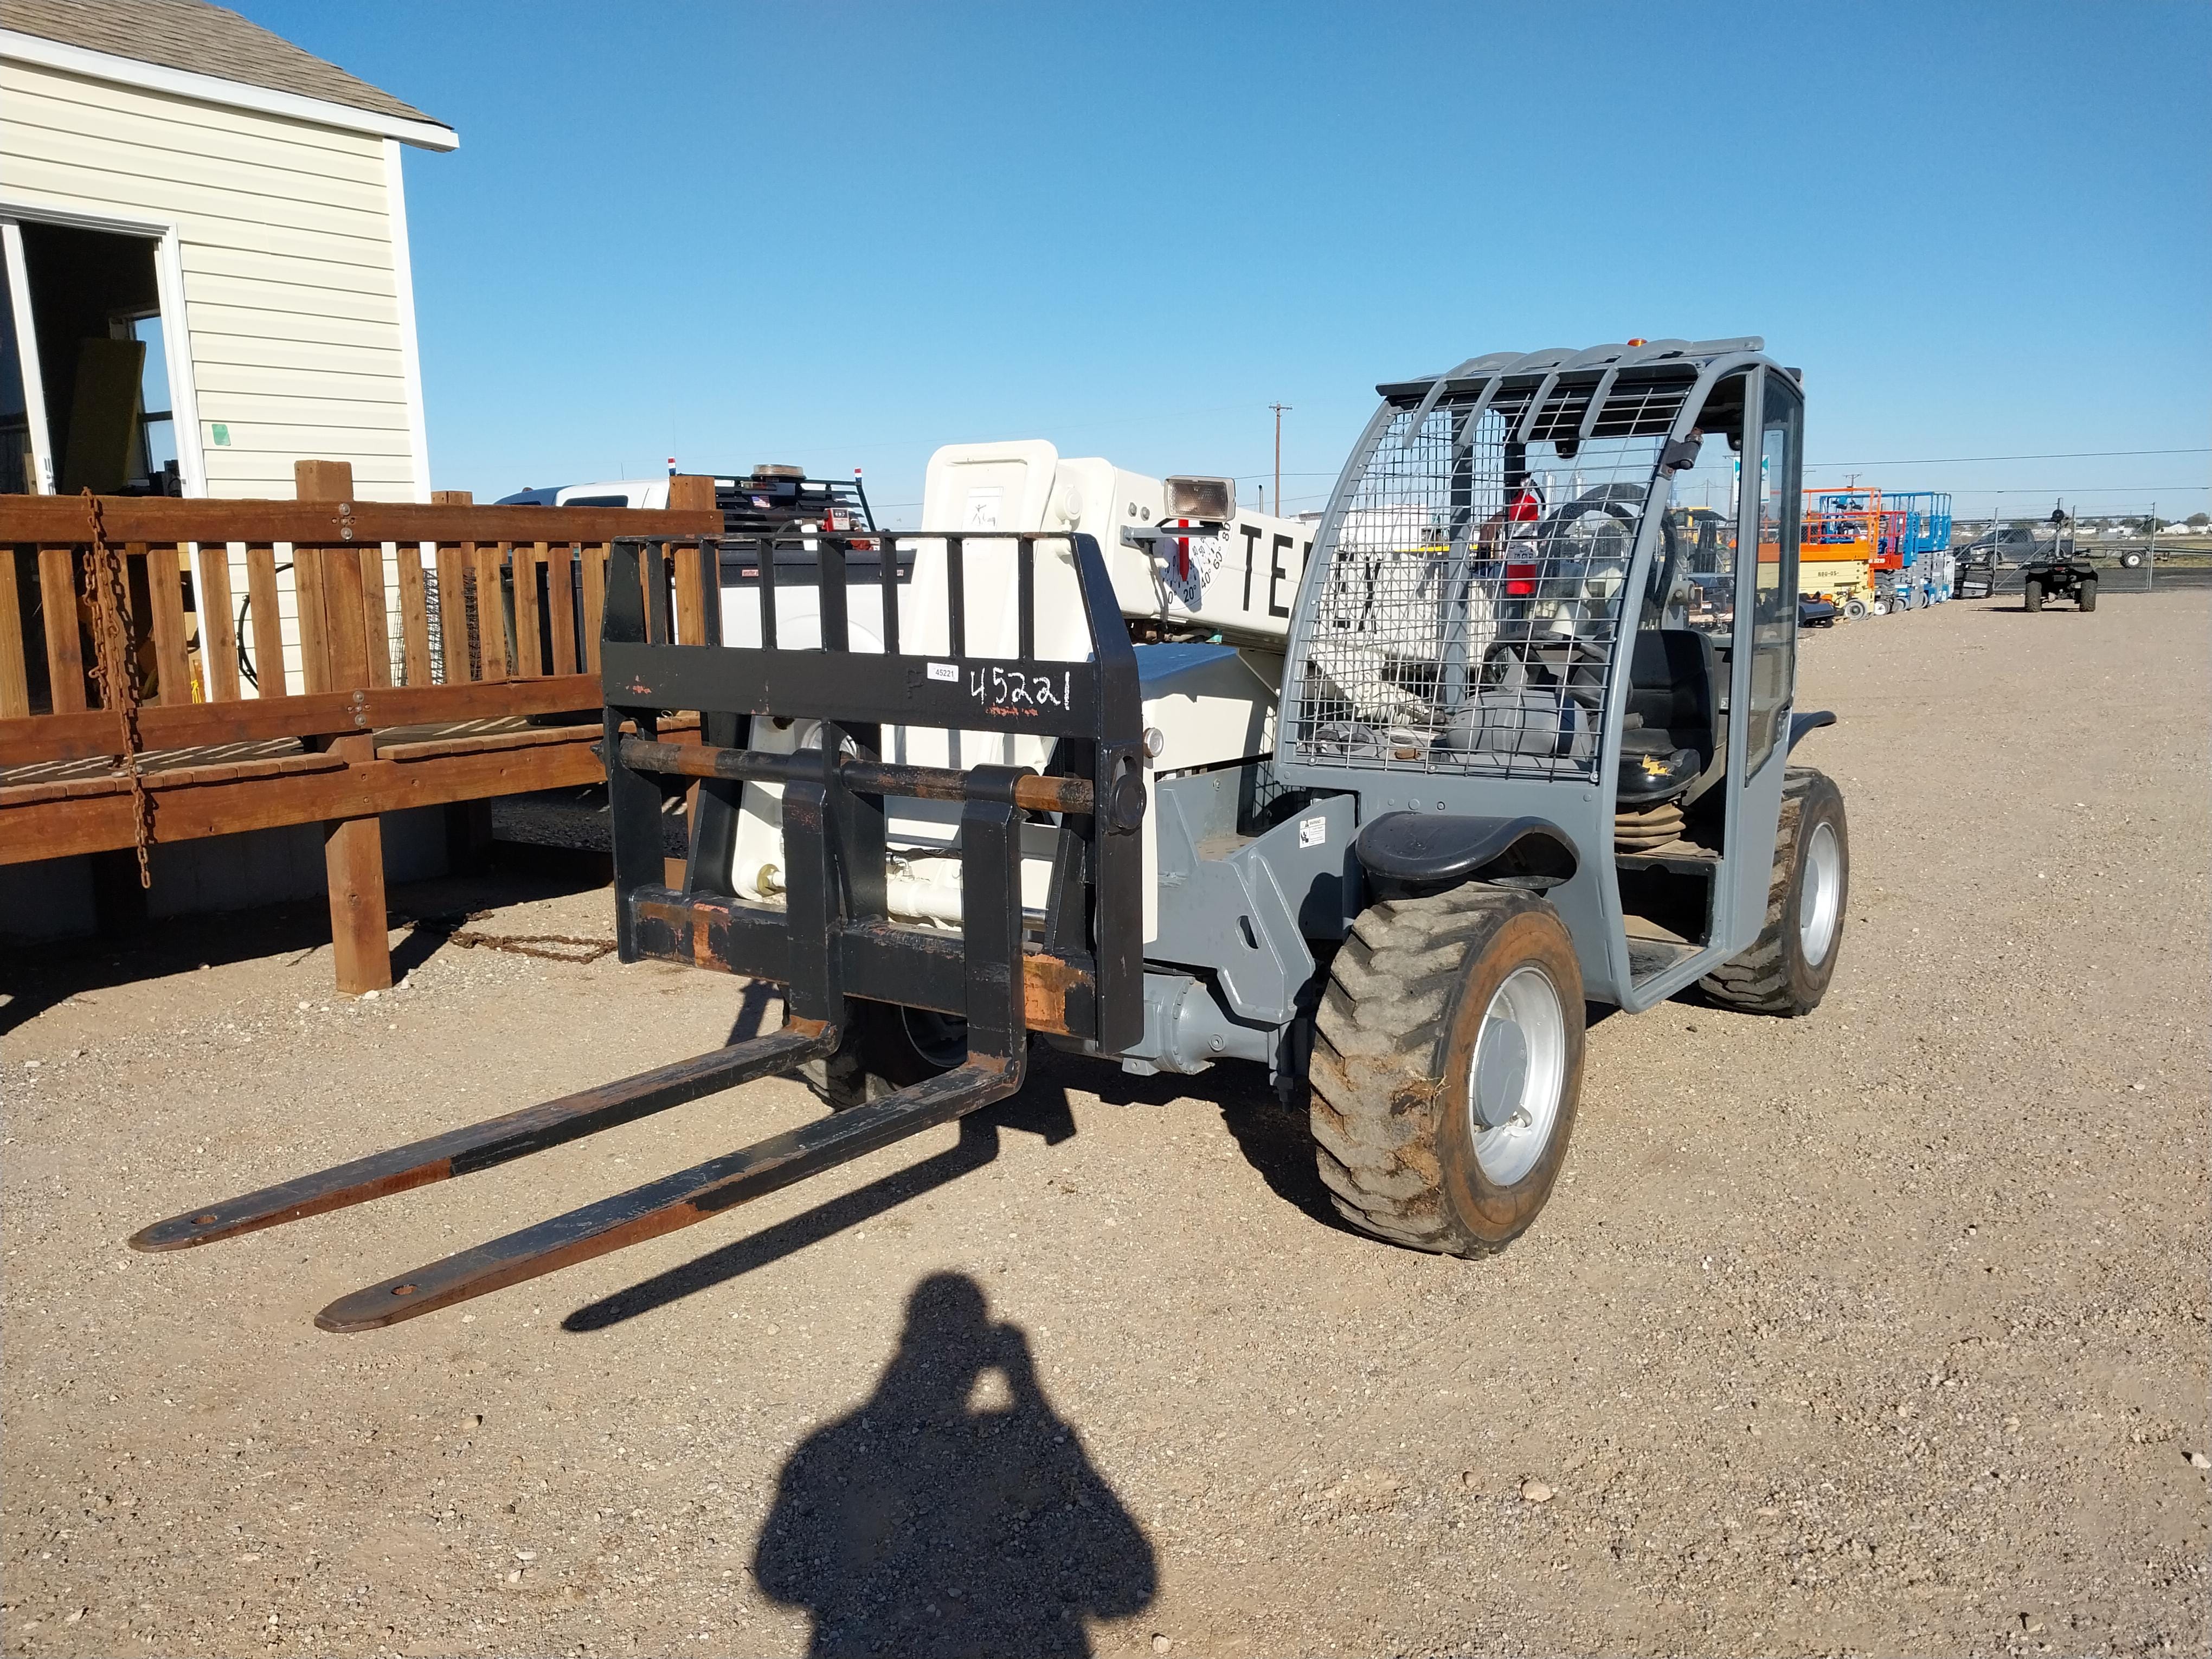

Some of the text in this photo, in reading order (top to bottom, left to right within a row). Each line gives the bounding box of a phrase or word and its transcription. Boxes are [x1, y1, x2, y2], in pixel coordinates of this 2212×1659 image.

[1239, 523, 1384, 635] TEEX
[935, 669, 954, 677] 45221
[970, 667, 1070, 710] 45221
